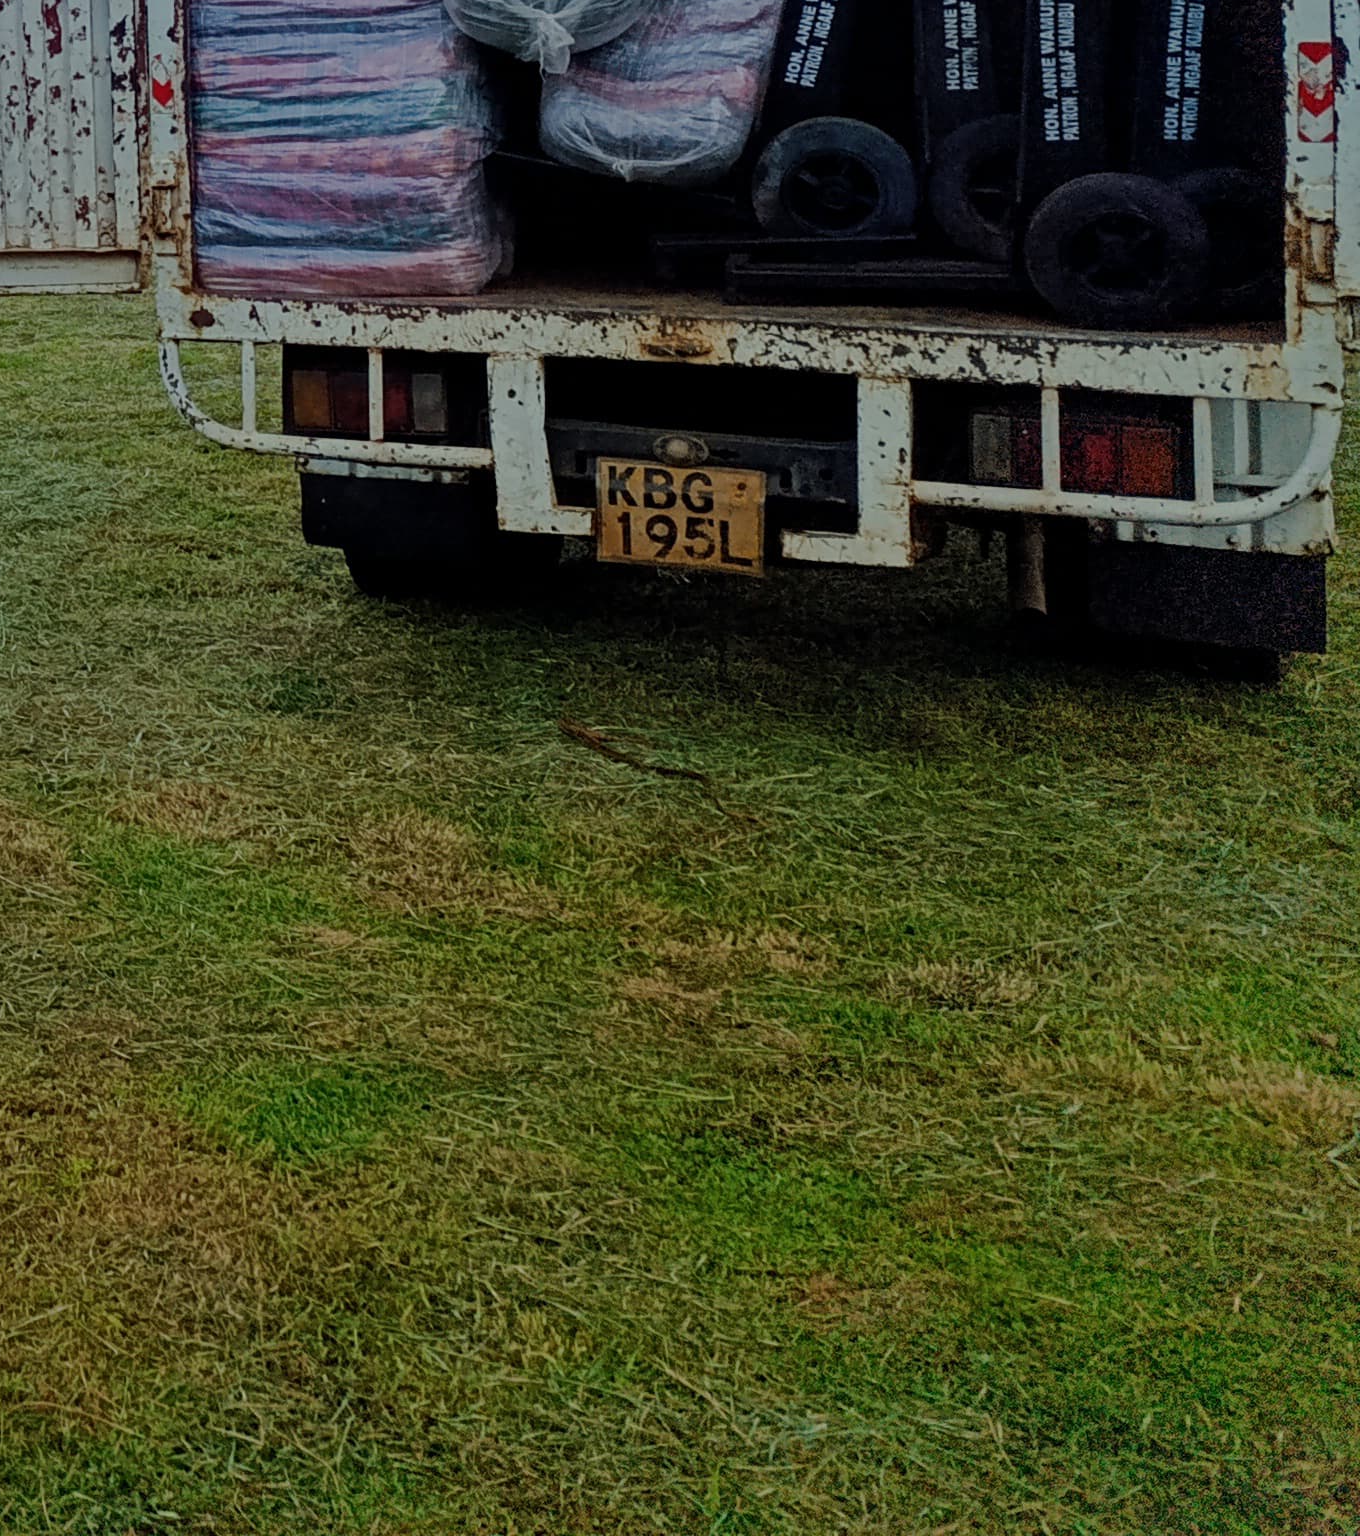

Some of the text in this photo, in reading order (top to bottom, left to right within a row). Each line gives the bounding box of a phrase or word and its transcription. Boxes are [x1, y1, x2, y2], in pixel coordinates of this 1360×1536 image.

[794, 5, 817, 47] ANNE
[812, 0, 836, 39] NGAAF
[943, 8, 960, 50] ANNE
[959, 0, 978, 39] NGAAF
[1057, 2, 1076, 48] KIAMBU
[1185, 2, 1206, 48] KIAMBU
[783, 49, 806, 84] HON.
[945, 53, 961, 91] HON.
[1040, 57, 1058, 100] ANNE
[1058, 49, 1077, 88] NGAAF
[1165, 56, 1182, 99] ANNE
[1183, 49, 1202, 88] NGAAF
[1043, 103, 1061, 141] HON.
[1163, 102, 1180, 140] HON.
[607, 466, 714, 513] KBG
[617, 512, 753, 566] 195L
